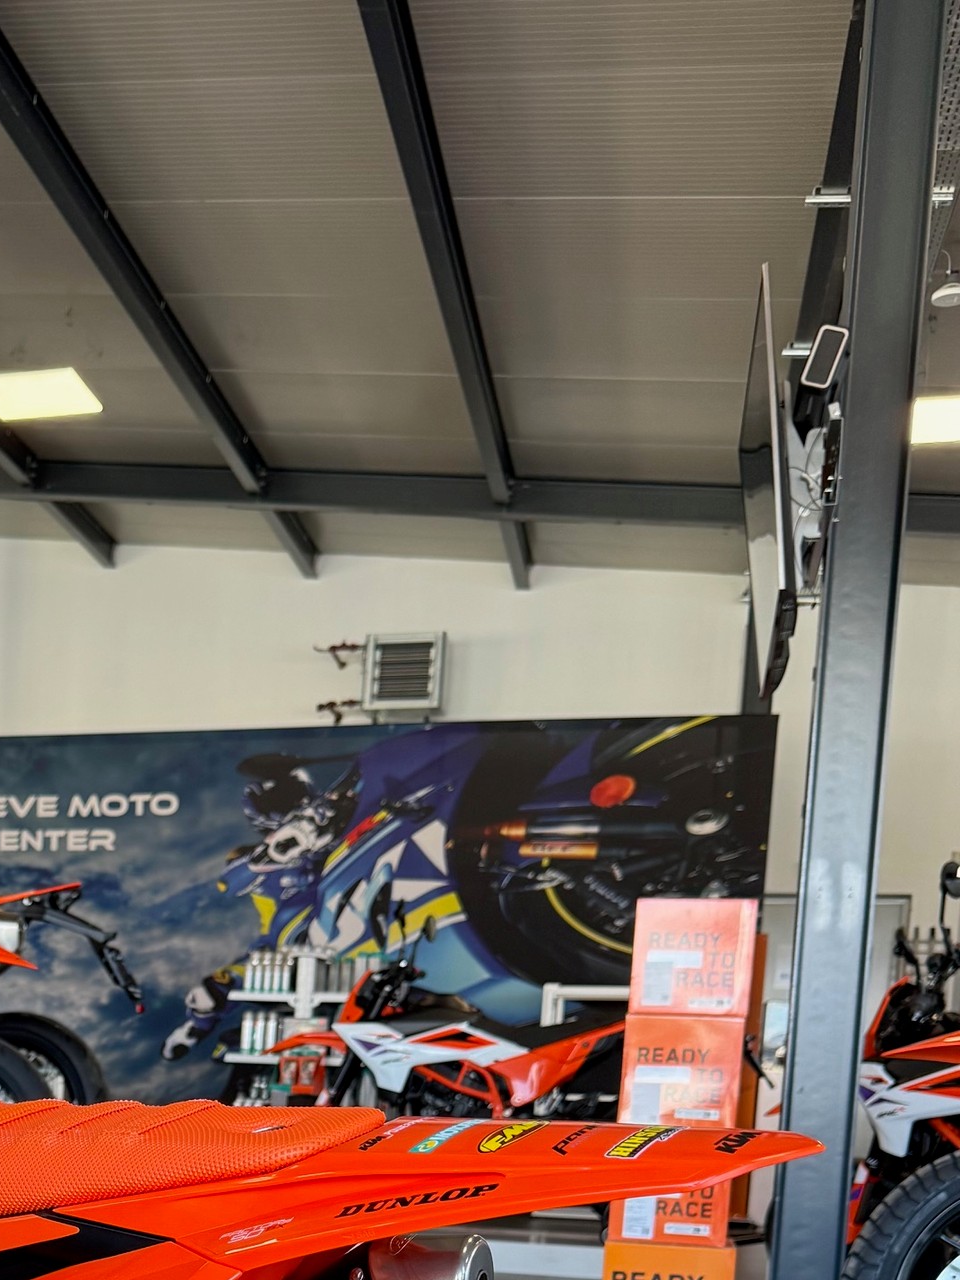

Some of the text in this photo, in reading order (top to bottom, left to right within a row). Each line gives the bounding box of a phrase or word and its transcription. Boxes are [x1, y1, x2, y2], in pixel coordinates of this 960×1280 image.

[67, 792, 180, 818] MOTO
[648, 931, 721, 949] READY
[708, 951, 735, 969] TO
[676, 971, 735, 988] RACE
[637, 1046, 710, 1064] READY
[696, 1067, 725, 1083] TO
[334, 1183, 500, 1218] DUNLOP
[656, 1201, 713, 1218] RACE
